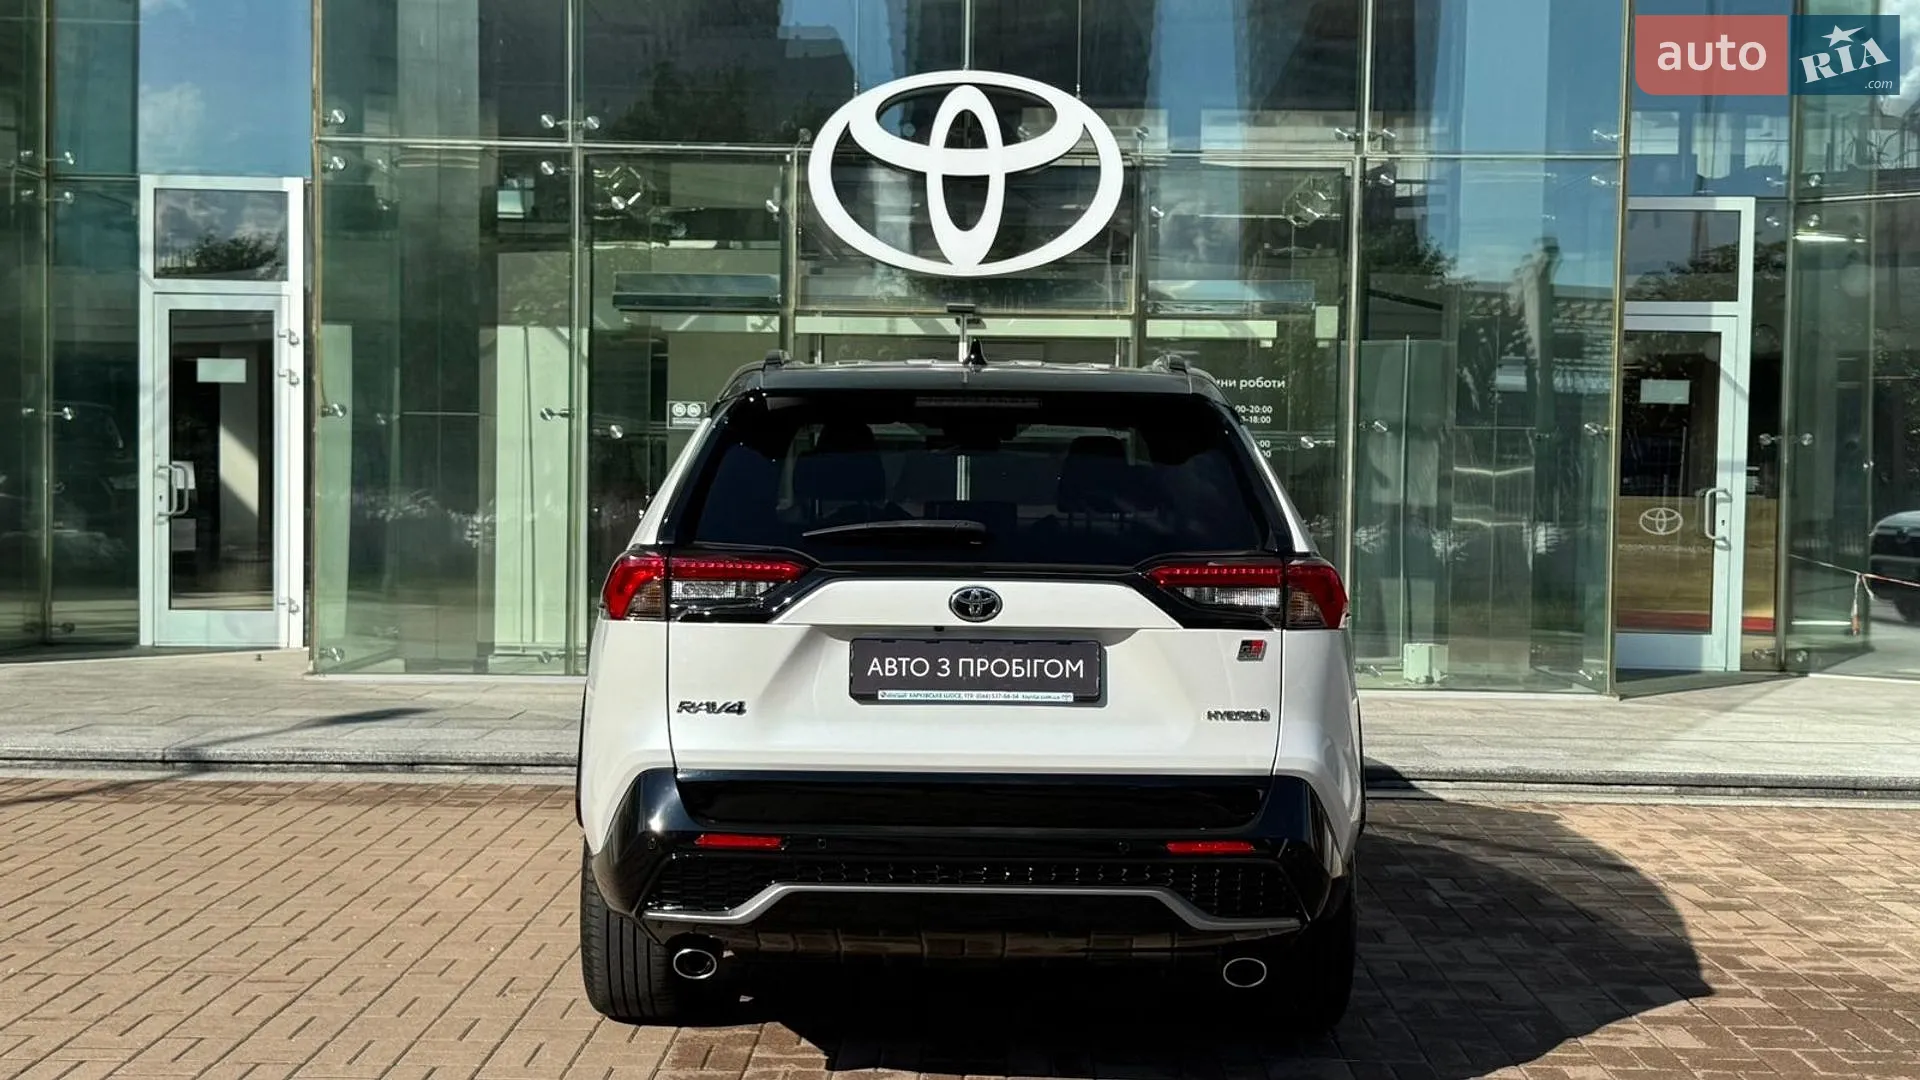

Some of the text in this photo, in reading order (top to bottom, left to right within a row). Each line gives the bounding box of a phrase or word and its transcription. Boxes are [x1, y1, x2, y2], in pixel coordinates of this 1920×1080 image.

[1216, 376, 1286, 390] ни роботи
[867, 657, 930, 678] АВТО
[958, 658, 1085, 679] ПРОБІГОМ
[676, 701, 747, 715] RAV4
[1207, 710, 1259, 722] HYBRID
